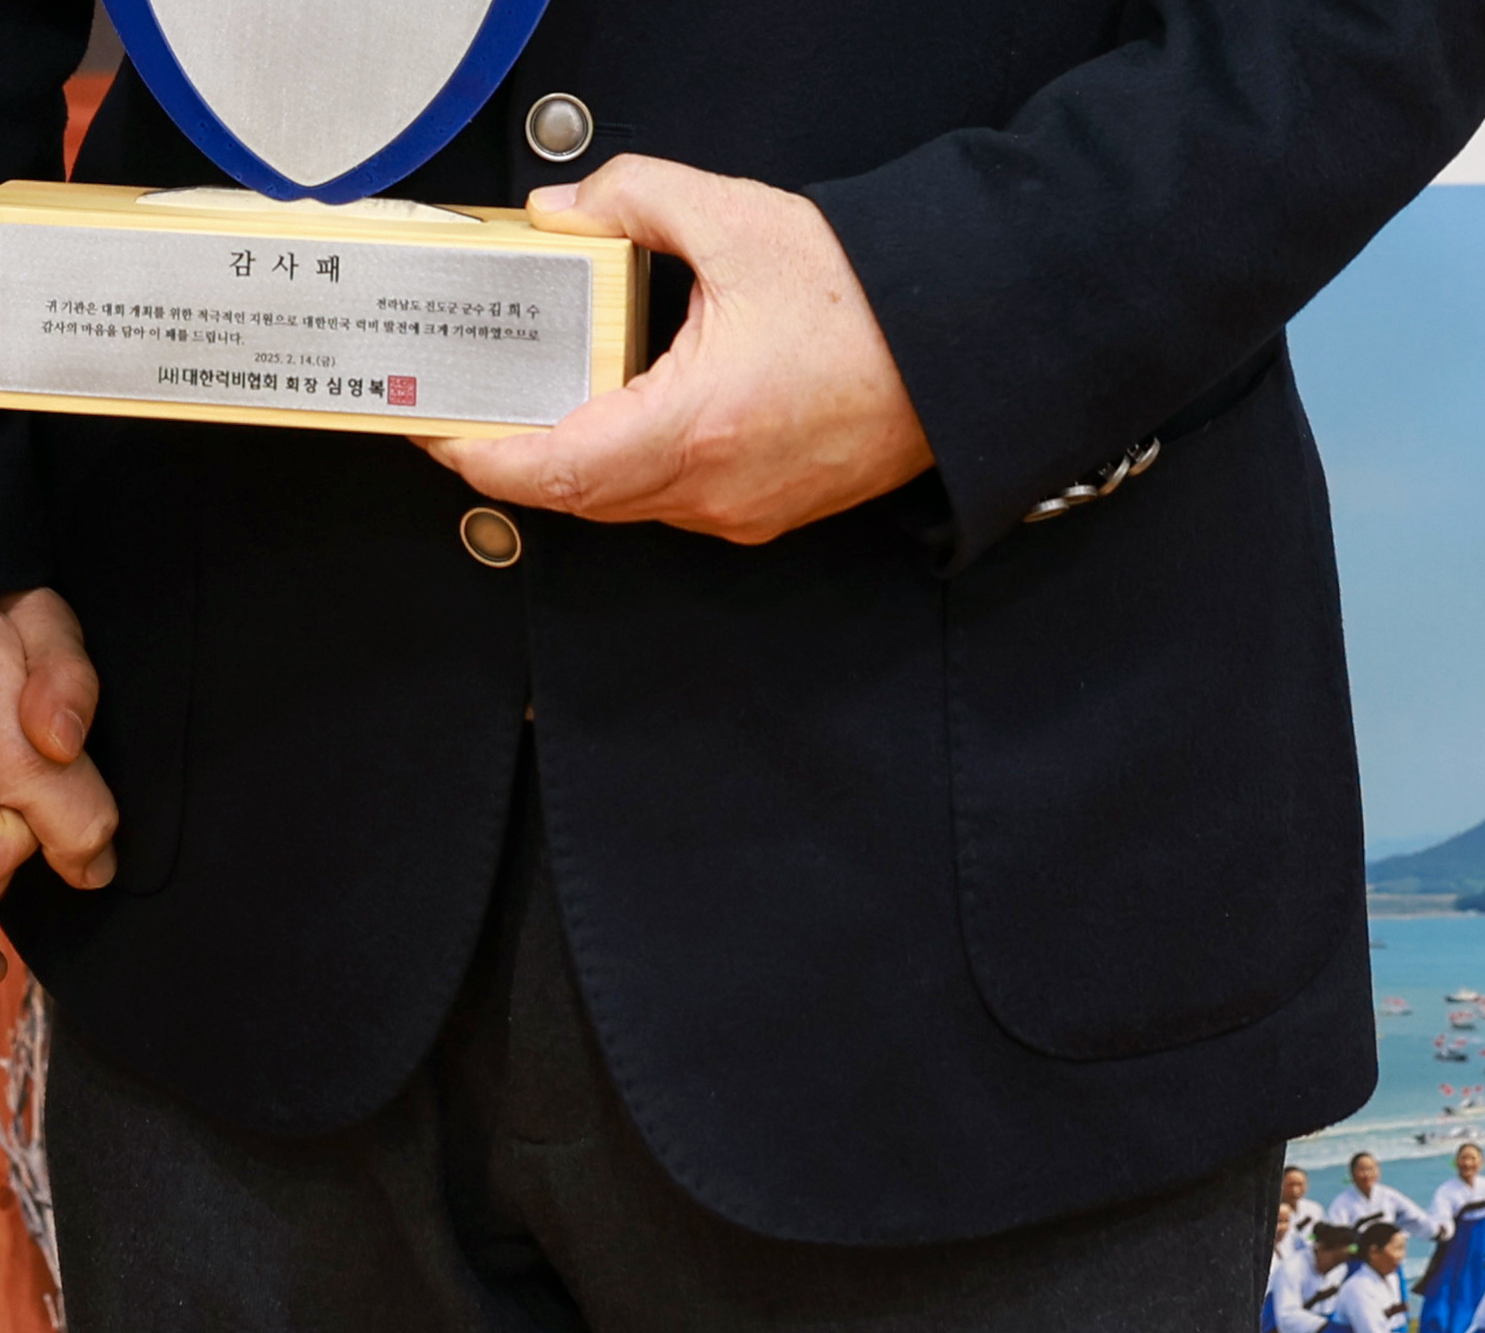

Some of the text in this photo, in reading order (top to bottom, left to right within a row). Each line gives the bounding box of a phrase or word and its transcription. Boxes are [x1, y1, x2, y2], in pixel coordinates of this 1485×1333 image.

[375, 297, 421, 312] 전라남도
[425, 300, 459, 315] 진도군
[462, 302, 485, 316] 군수
[45, 299, 541, 342] 귀 기관은 대회 개최를 위한 적극적인 지원으로 대한민국 럭비 발전에 크게 기여하였으므로
[41, 319, 246, 346] 감사의 마음을 담아 이 패를 드립니다.
[253, 352, 284, 366] 2025.
